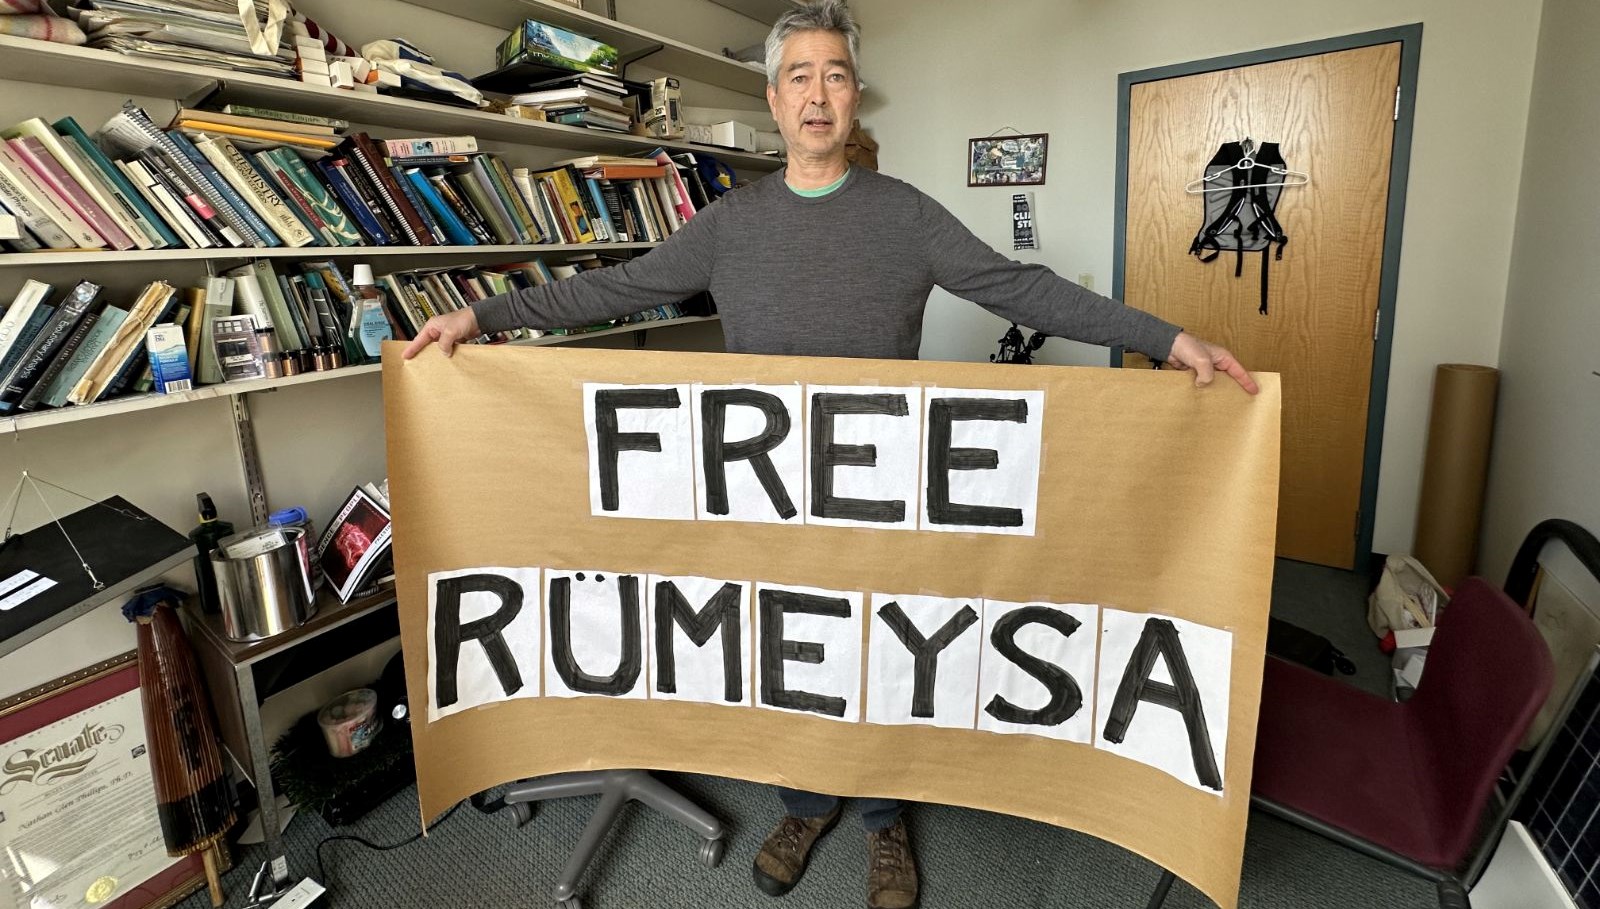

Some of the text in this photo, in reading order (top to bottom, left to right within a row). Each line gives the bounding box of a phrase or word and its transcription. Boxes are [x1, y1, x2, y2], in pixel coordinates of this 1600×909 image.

[224, 141, 283, 211] CHEMISTRY
[10, 194, 33, 218] Physics
[35, 316, 69, 358] Evolutionary
[19, 353, 43, 382] Analysis
[595, 387, 1029, 527] FREE
[337, 491, 362, 521] PEOPLE
[435, 572, 1224, 791] RÜMEYSA
[0, 722, 125, 795] Senate
